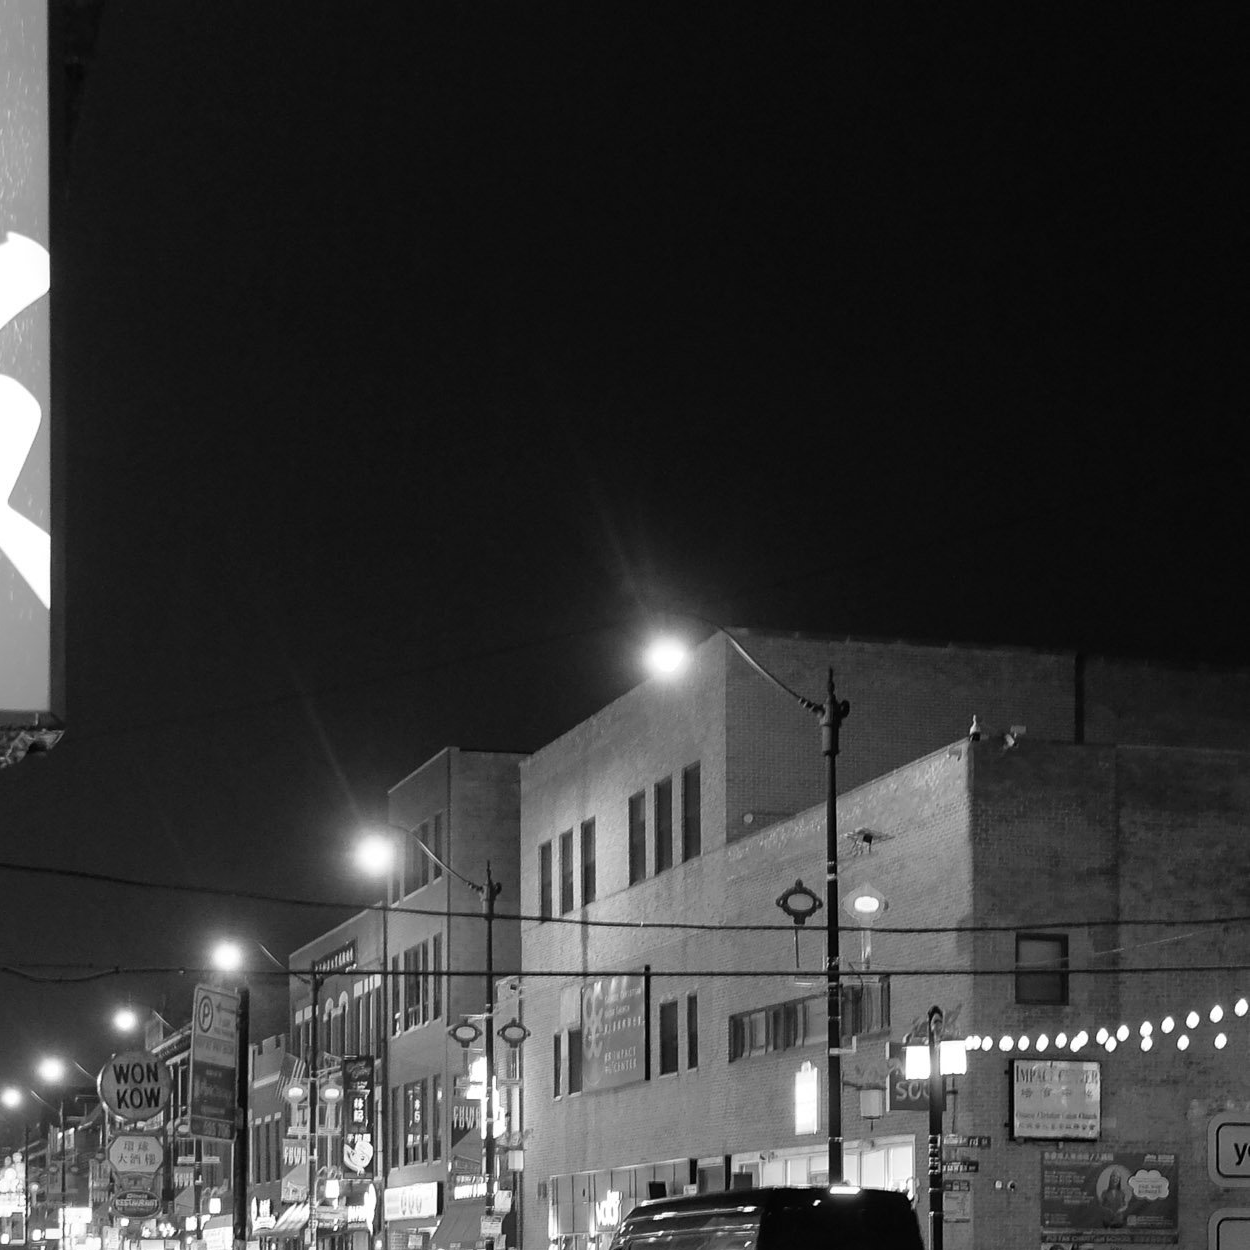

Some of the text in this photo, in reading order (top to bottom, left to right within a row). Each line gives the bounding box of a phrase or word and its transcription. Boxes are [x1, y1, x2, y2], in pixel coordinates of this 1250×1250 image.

[113, 1061, 159, 1085] WON
[1016, 1064, 1054, 1084] IMPACT
[117, 1085, 161, 1109] KOW
